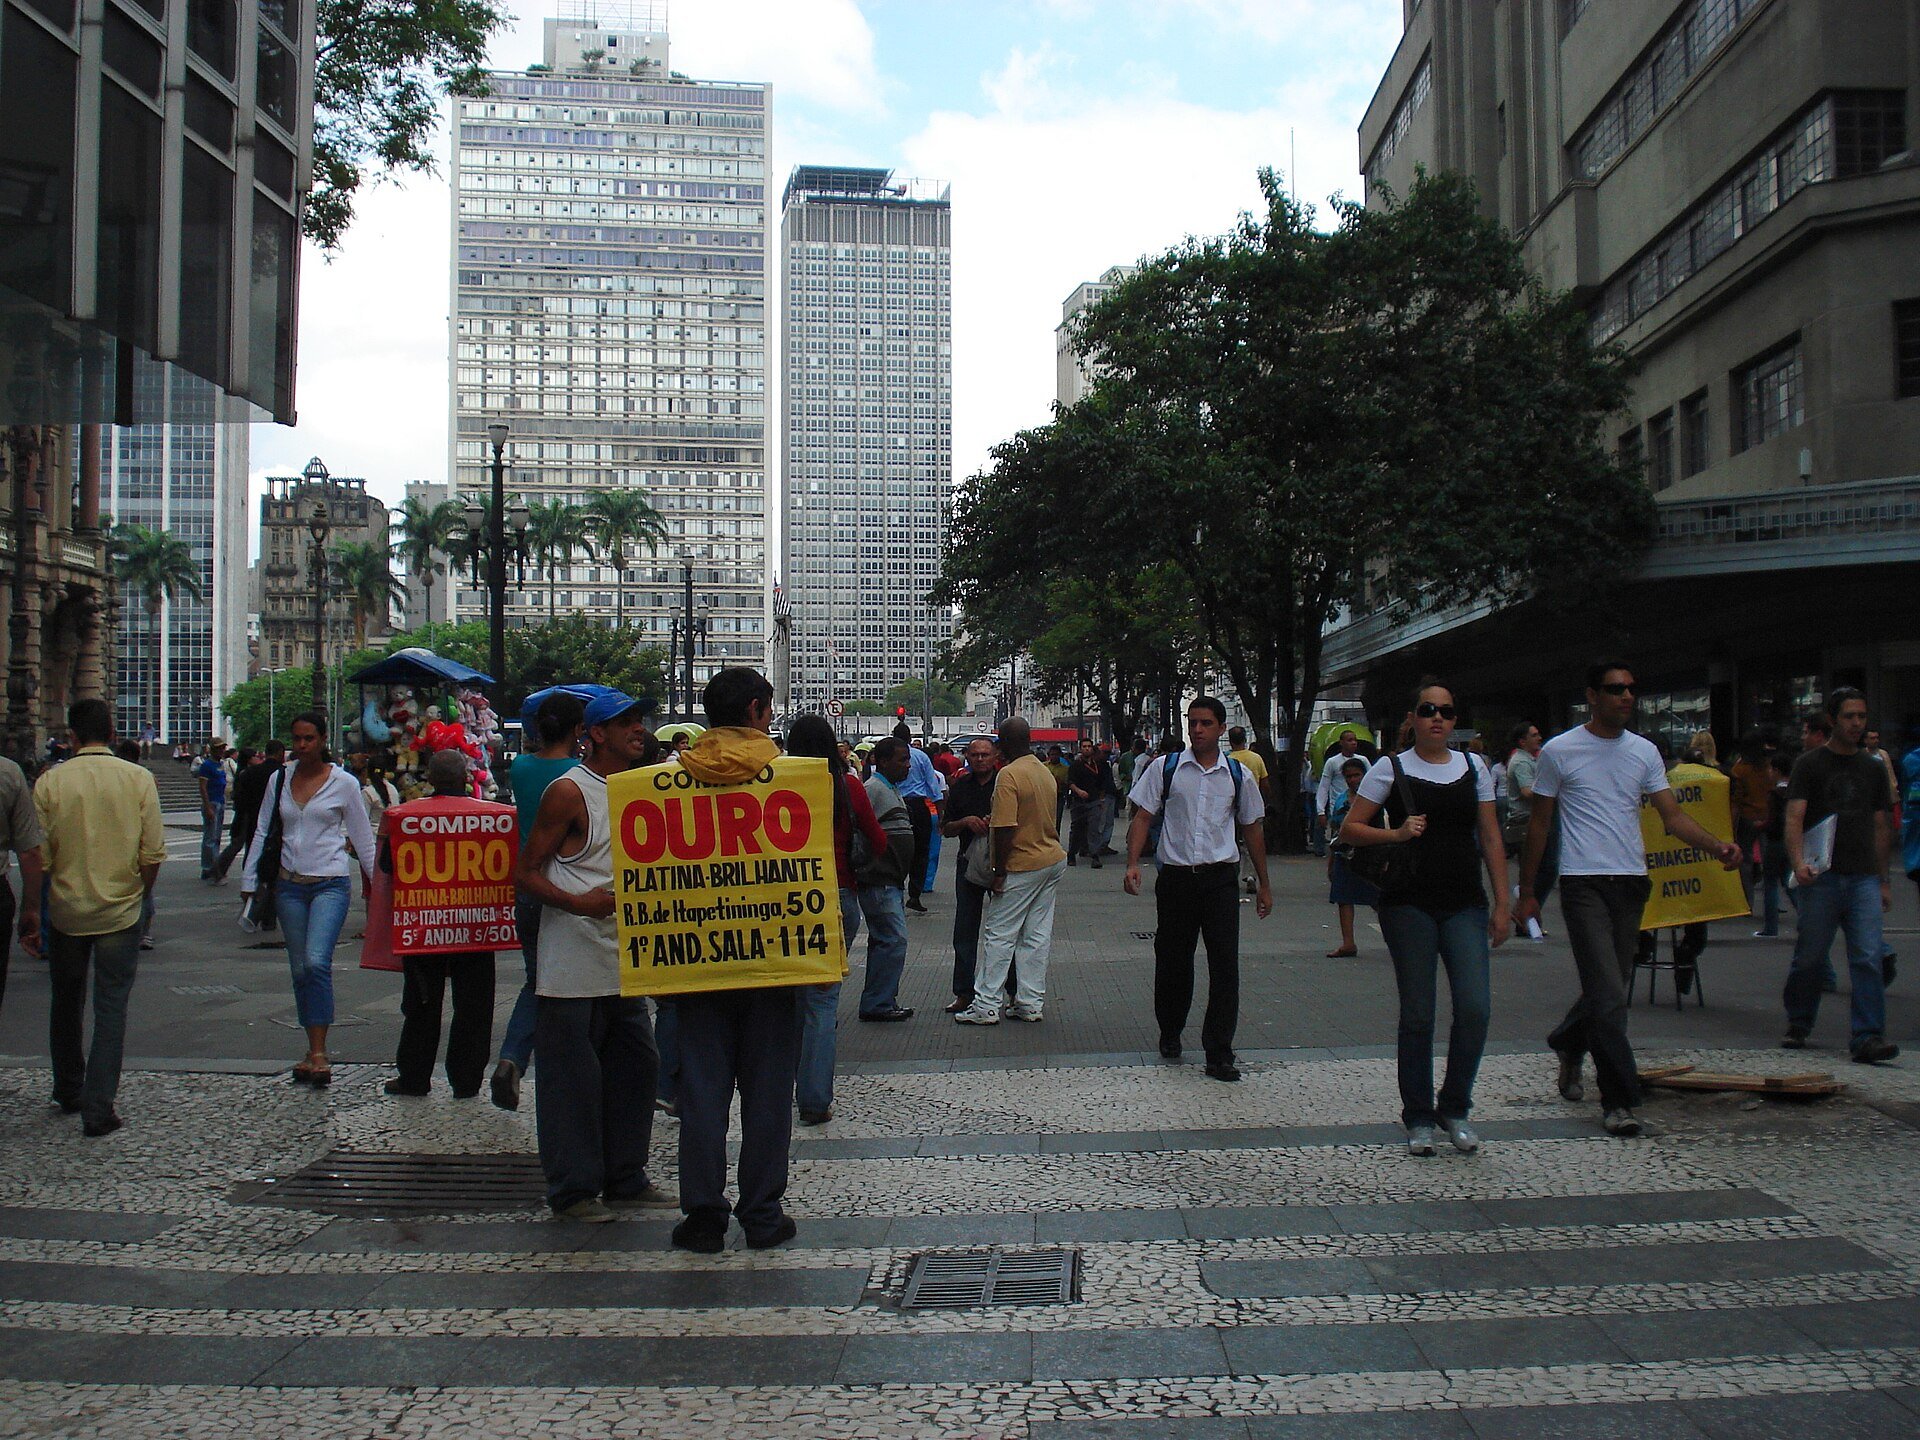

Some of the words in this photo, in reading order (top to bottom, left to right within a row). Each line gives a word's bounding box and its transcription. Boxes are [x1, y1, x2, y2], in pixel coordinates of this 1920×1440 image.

[653, 764, 774, 791] COO
[401, 814, 513, 834] COMPRO
[620, 789, 812, 863] OURO
[396, 839, 510, 884] OURO
[623, 858, 824, 893] PLATINA-BRILHANTE
[1662, 878, 1701, 898] ATIVO
[420, 906, 496, 926] ITAPETININGA
[424, 928, 470, 946] ANDAR
